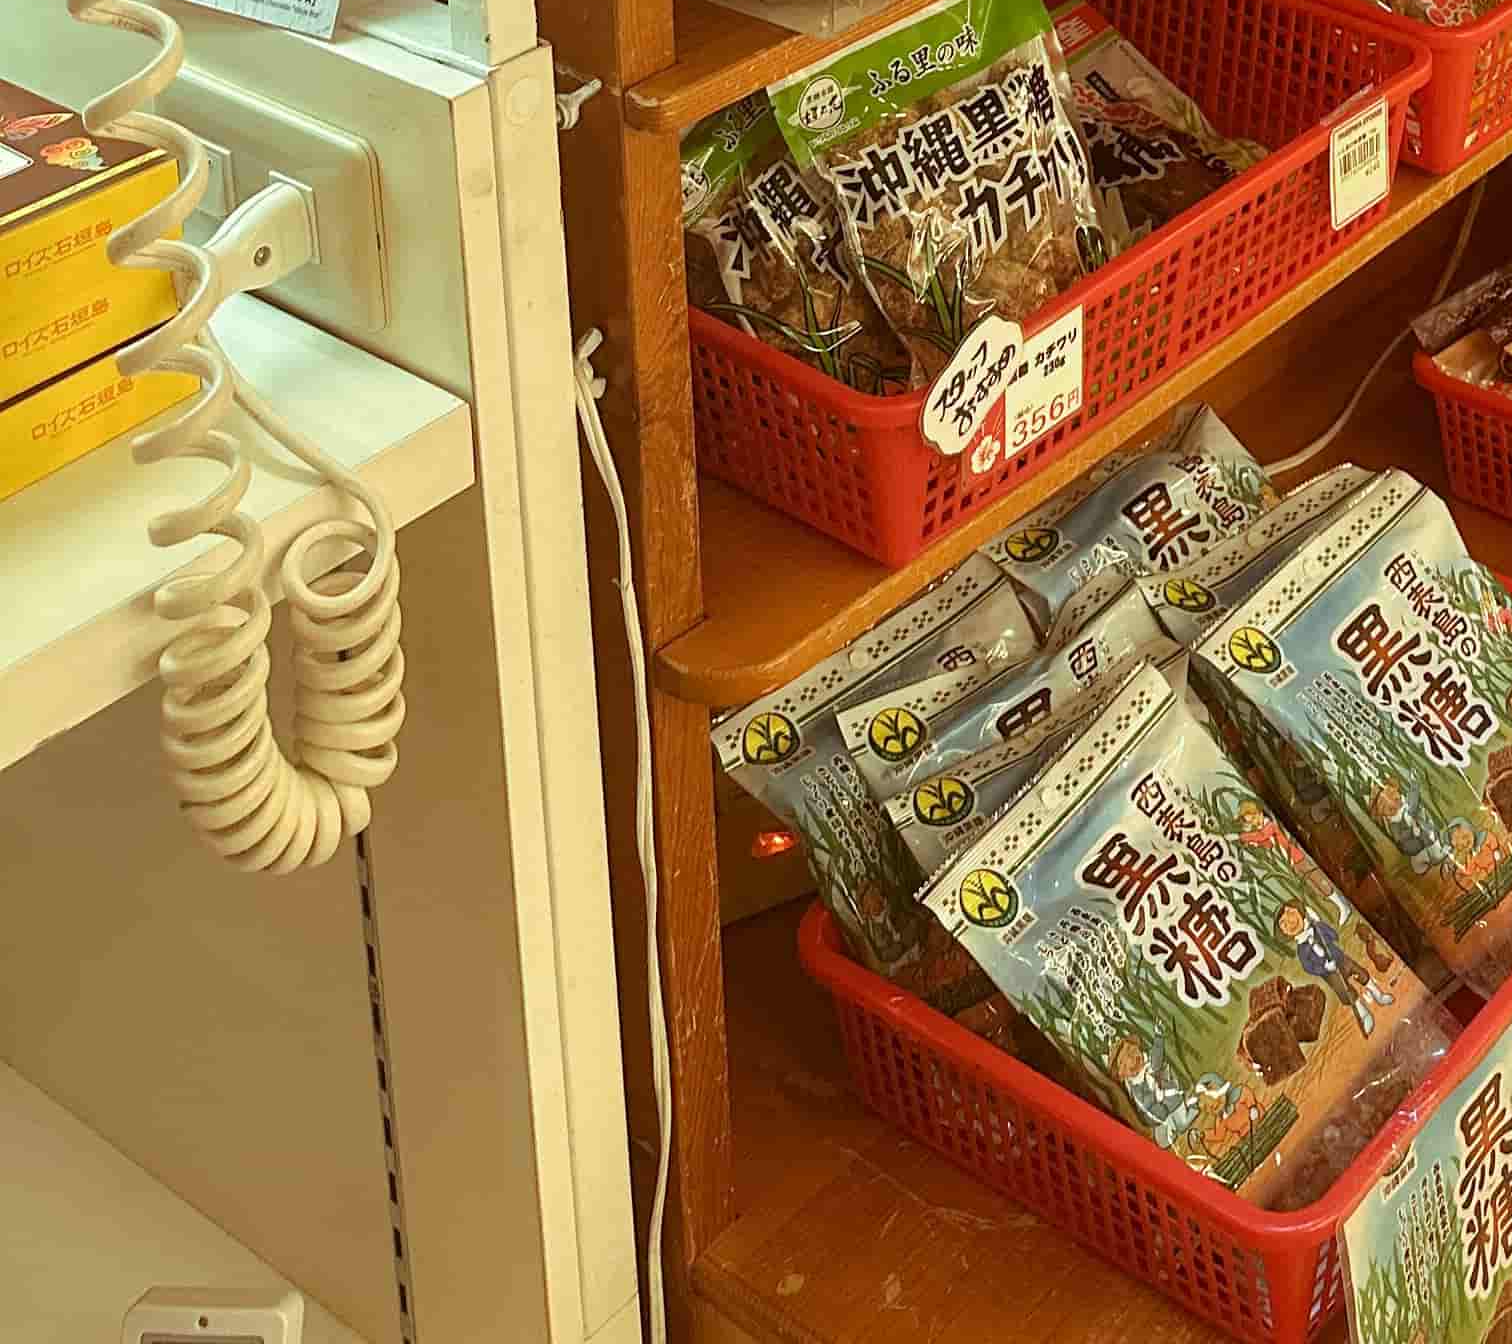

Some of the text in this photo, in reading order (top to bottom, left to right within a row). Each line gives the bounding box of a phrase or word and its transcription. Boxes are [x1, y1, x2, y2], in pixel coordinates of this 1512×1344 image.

[866, 24, 979, 98] ふる里の味
[838, 63, 1057, 226] 沖縄黒糖
[4, 219, 113, 280] ロイズ石垣島
[2, 297, 111, 361] ロイズ石垣島
[1035, 328, 1077, 368] カチワリ
[31, 375, 136, 442] ロイズ石垣島
[1012, 387, 1080, 448] 356円
[1122, 481, 1212, 571] 黒
[1383, 552, 1477, 657] 西表島の
[1337, 603, 1492, 761] 黒糖
[1131, 772, 1238, 882] 西表島の
[1082, 832, 1258, 1001] 黒糖
